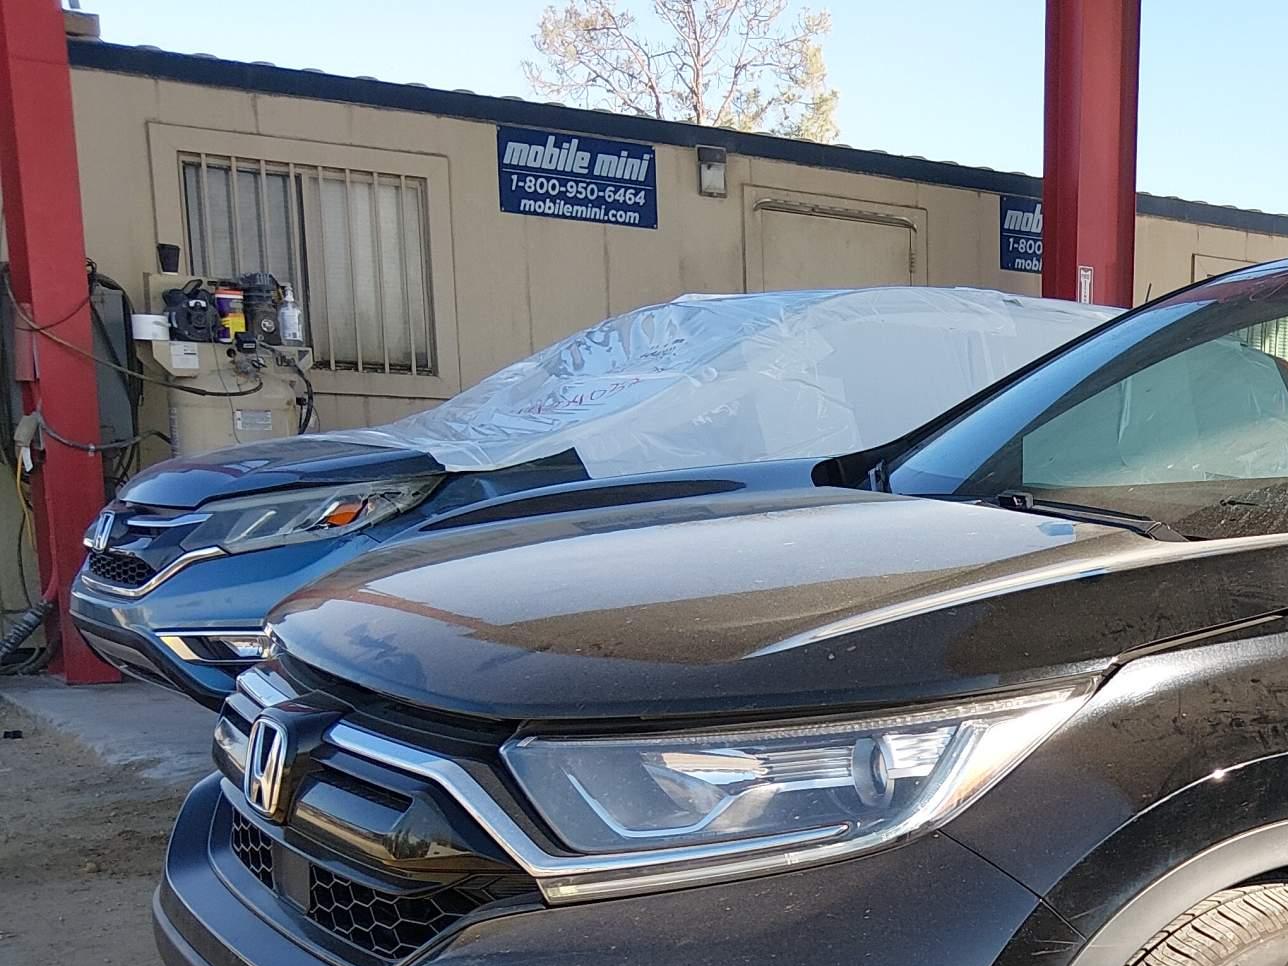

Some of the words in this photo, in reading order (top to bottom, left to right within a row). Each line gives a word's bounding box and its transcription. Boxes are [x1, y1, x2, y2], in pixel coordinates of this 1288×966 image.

[503, 135, 591, 175] mobile
[593, 150, 650, 181] mini
[511, 174, 646, 206] 1-800-950-6464
[520, 198, 640, 224] mobilemini.com
